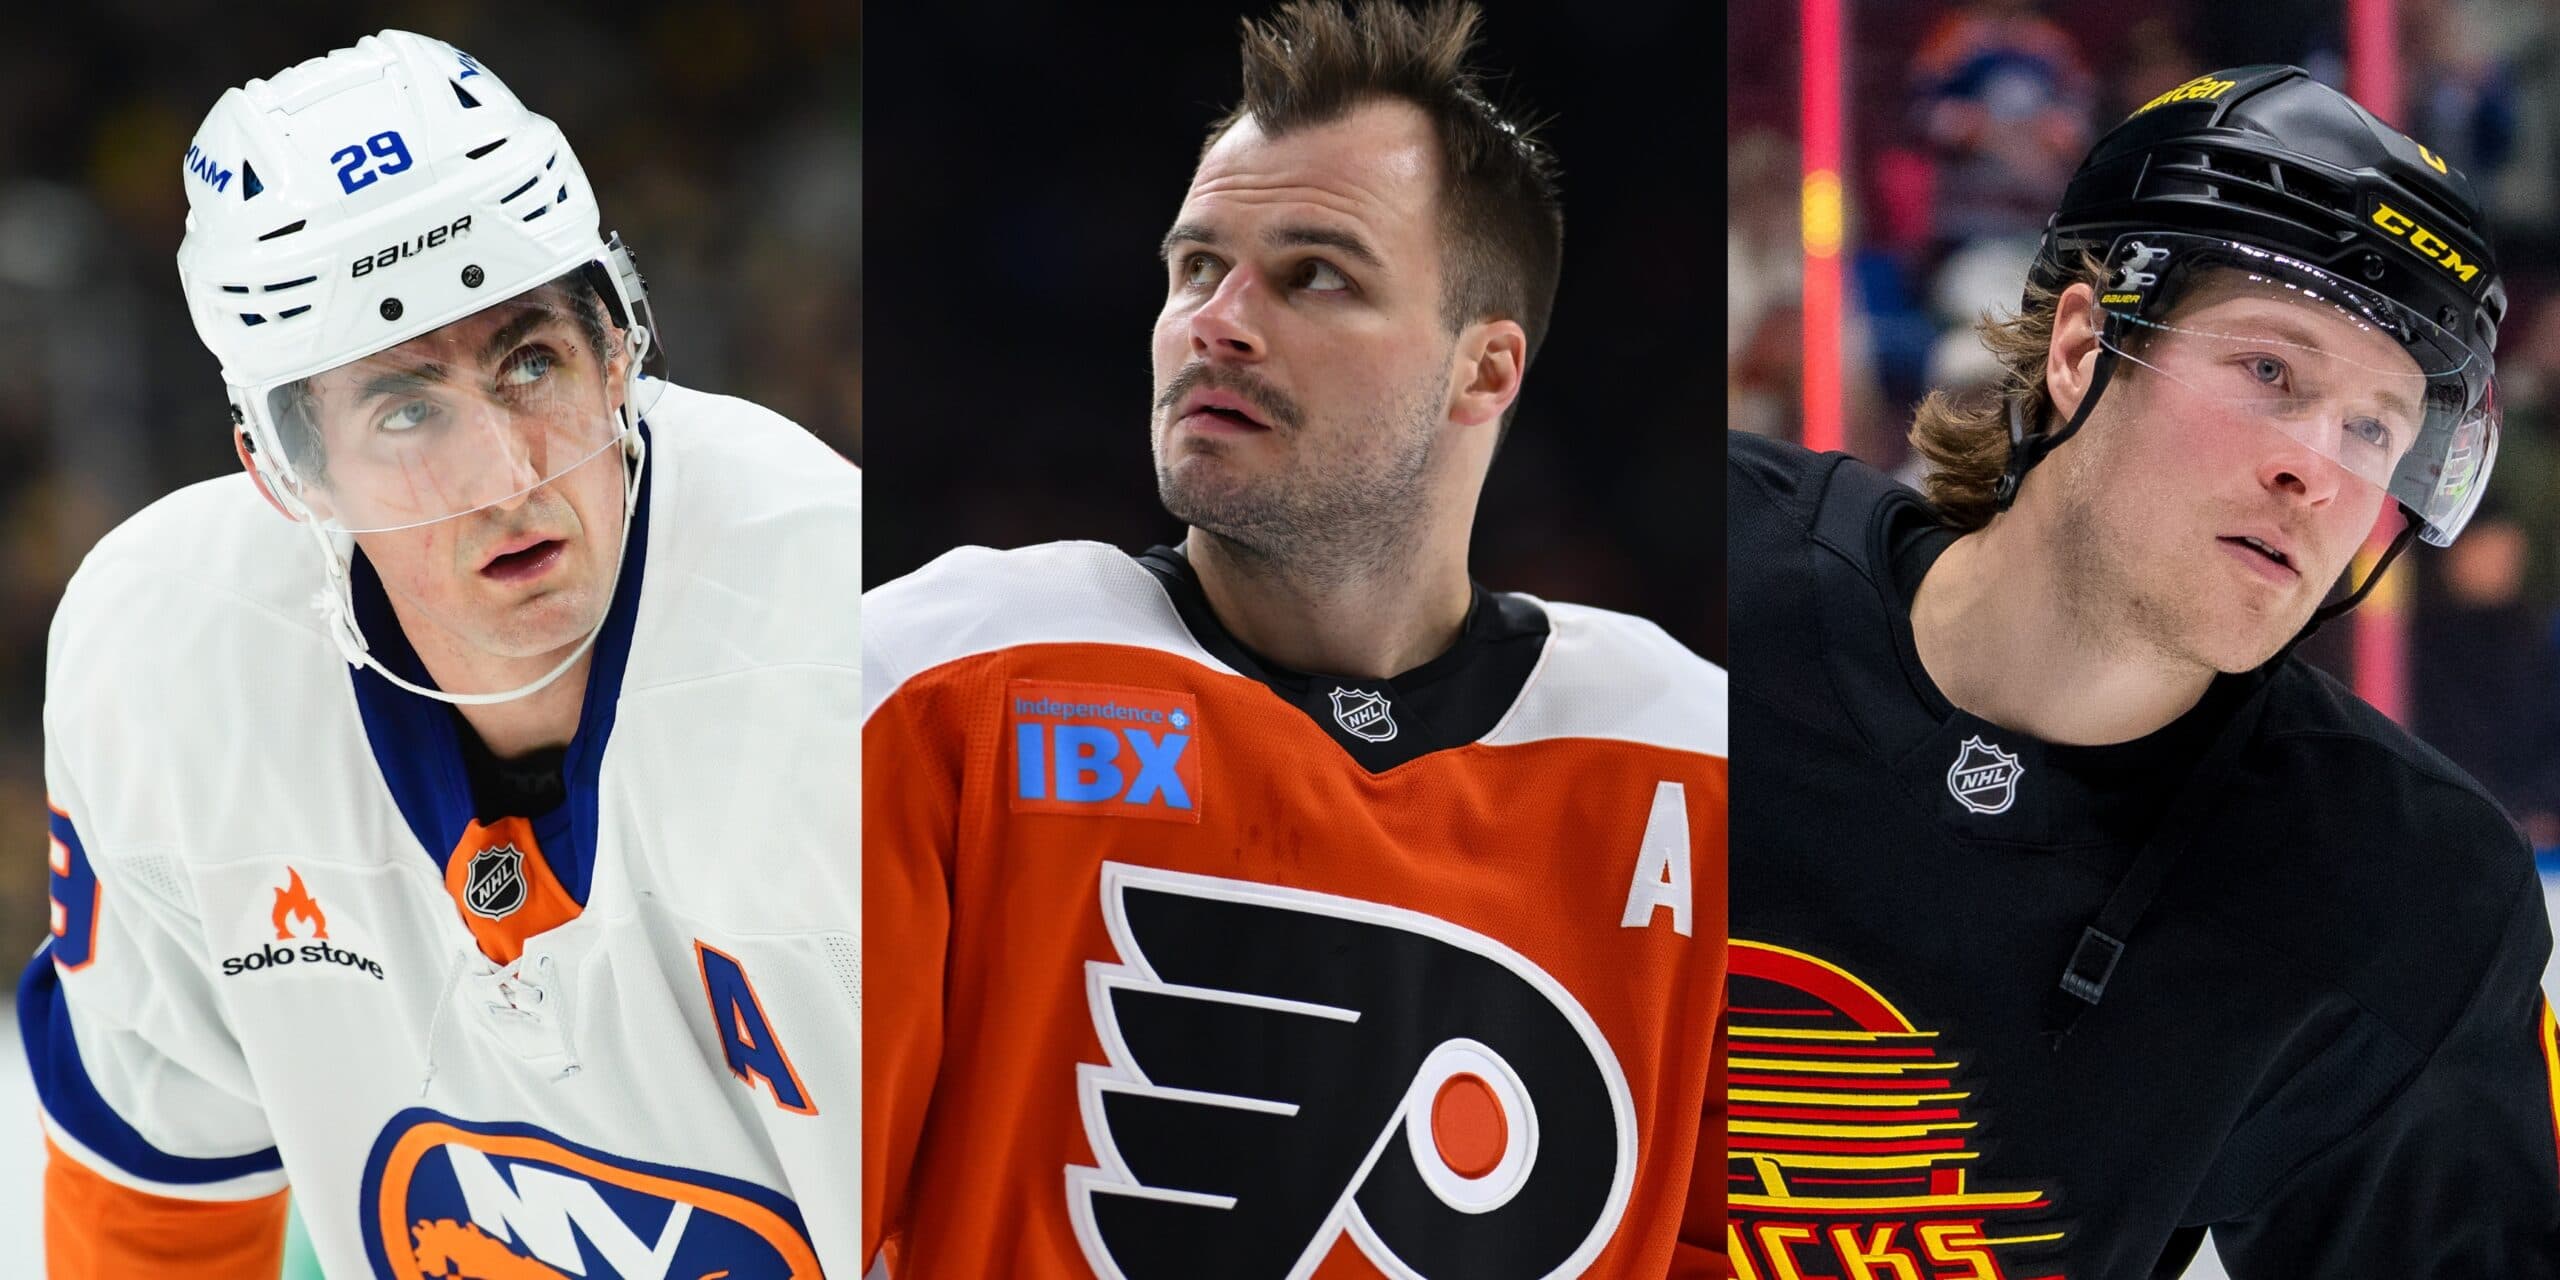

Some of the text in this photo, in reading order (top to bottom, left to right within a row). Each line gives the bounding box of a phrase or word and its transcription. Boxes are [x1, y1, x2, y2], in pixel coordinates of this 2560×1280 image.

[330, 130, 413, 195] 29
[2372, 203, 2479, 282] CCM
[1015, 697, 1163, 724] Independence
[1348, 706, 1381, 728] NHL
[1016, 723, 1193, 810] IBX
[1960, 767, 2006, 790] NHL
[478, 862, 513, 905] NHL
[1620, 780, 1693, 938] A
[222, 941, 384, 980] solo stove
[694, 937, 820, 1116] A
